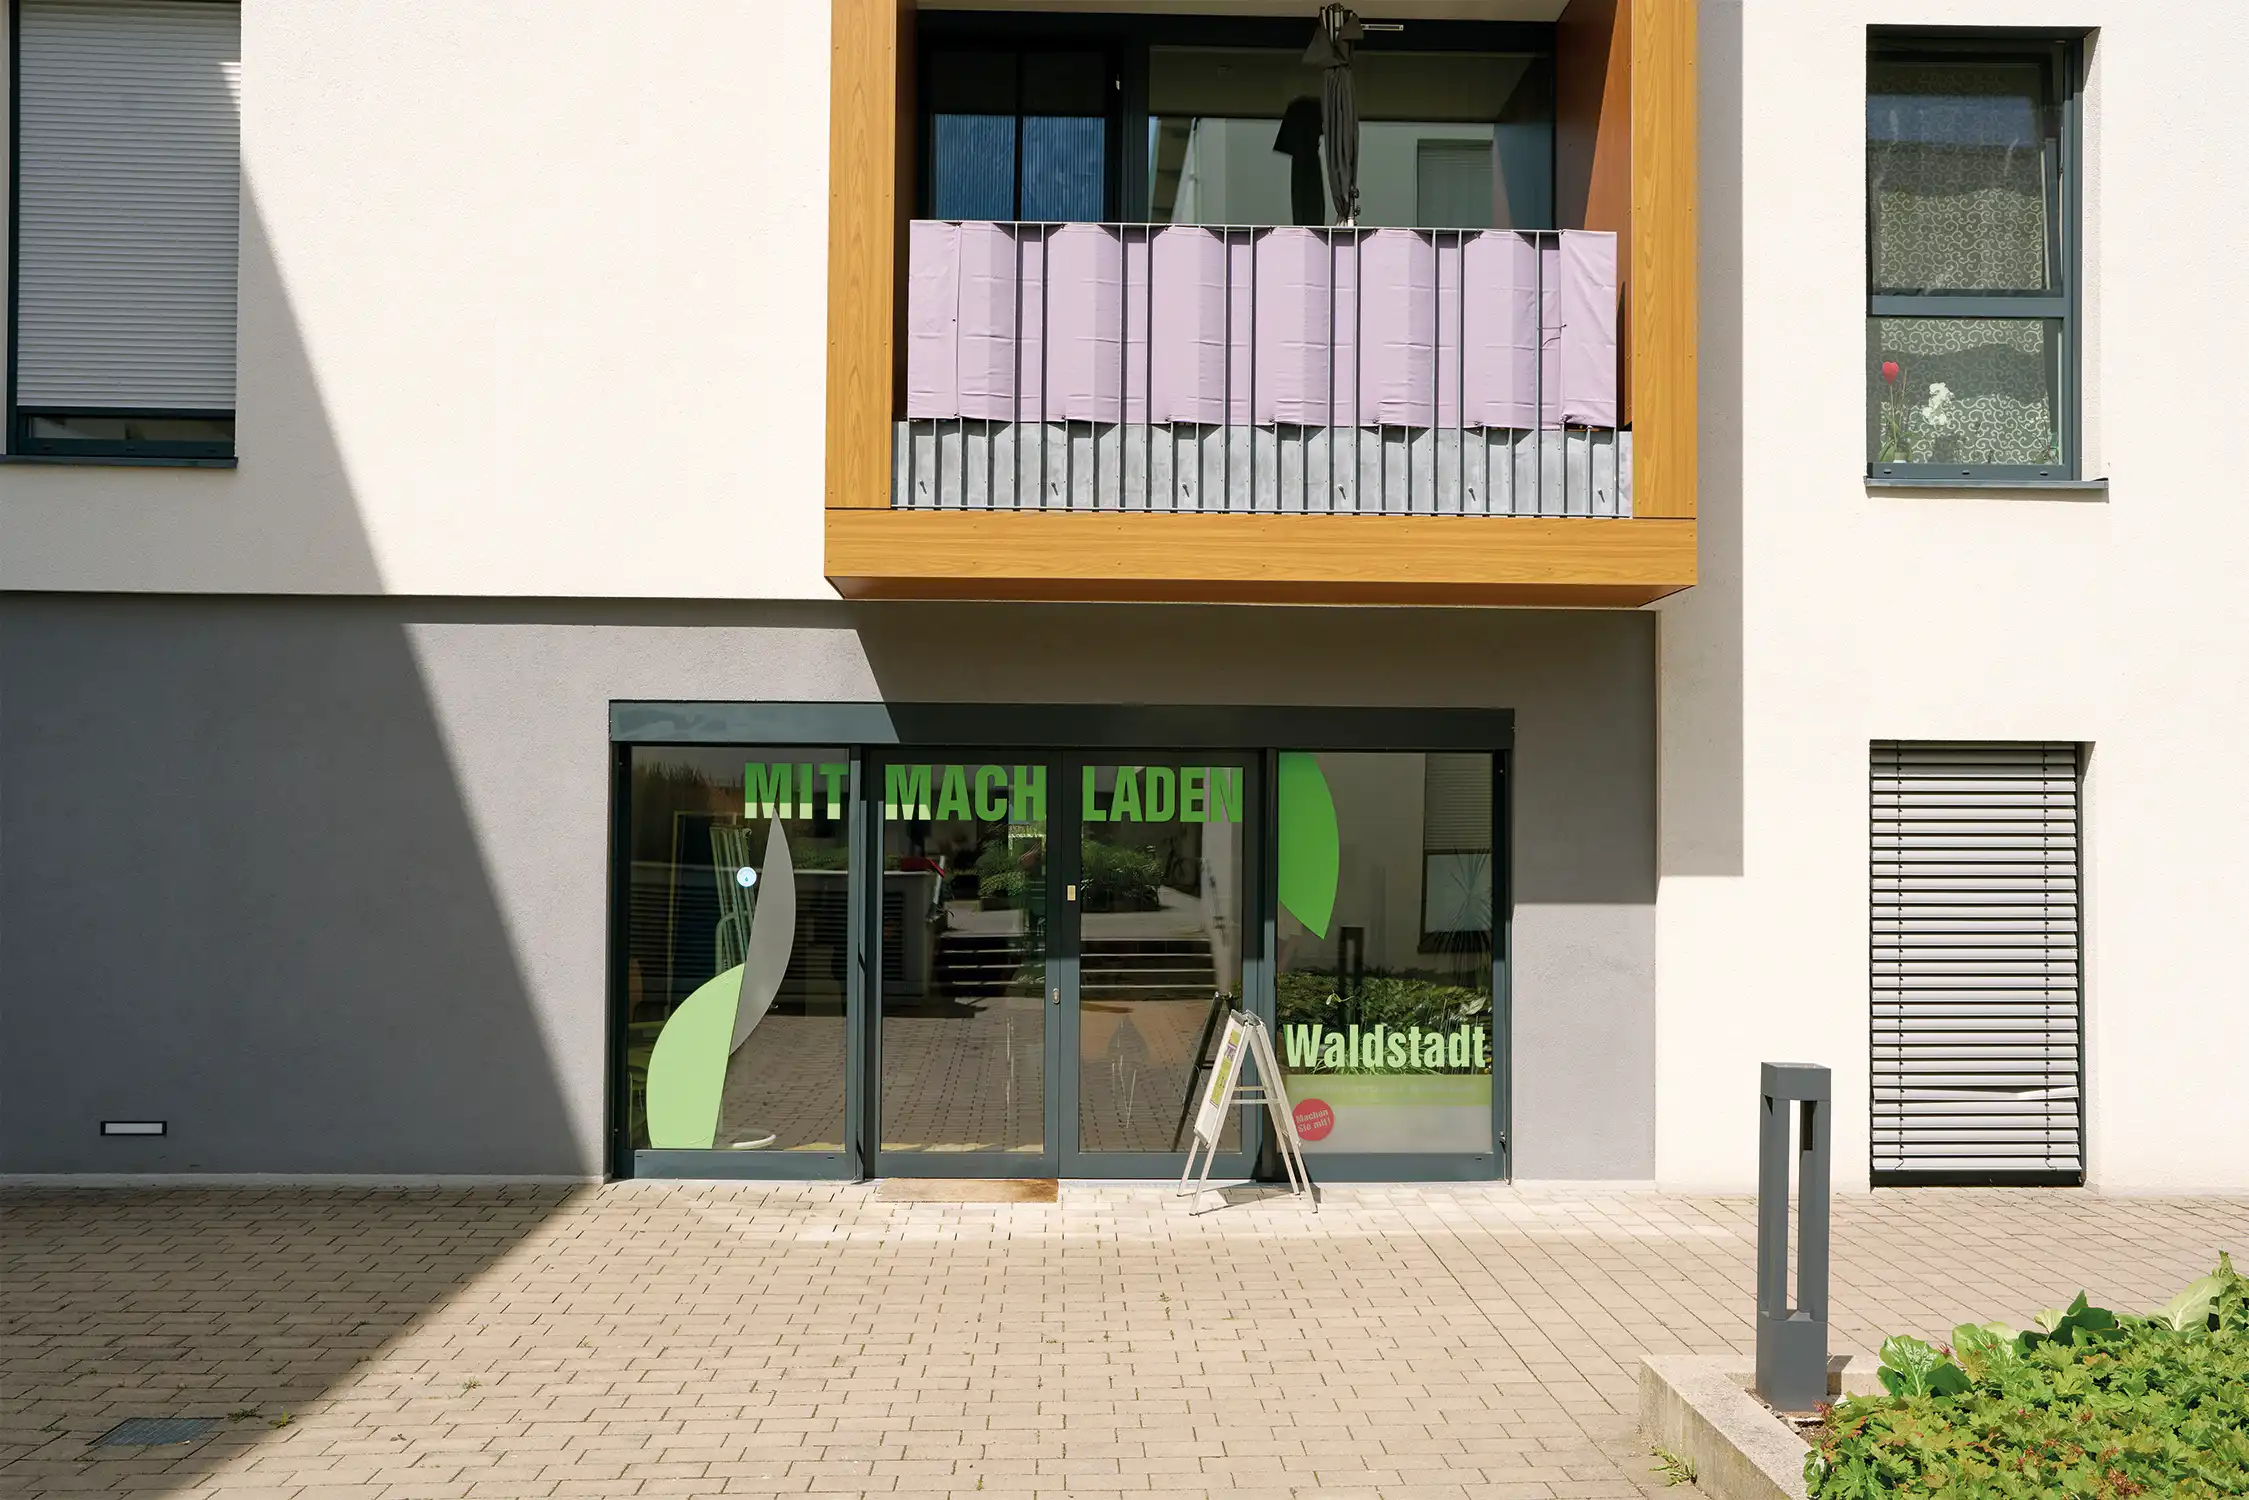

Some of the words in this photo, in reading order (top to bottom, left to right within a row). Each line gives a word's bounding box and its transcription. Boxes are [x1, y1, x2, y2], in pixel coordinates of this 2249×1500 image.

[744, 762, 848, 820] MIT
[885, 764, 1047, 821] MACH
[1082, 765, 1243, 823] LADEN
[1285, 1024, 1486, 1068] Waldstadt
[1295, 1109, 1329, 1123] Machen
[1298, 1123, 1311, 1132] Sie
